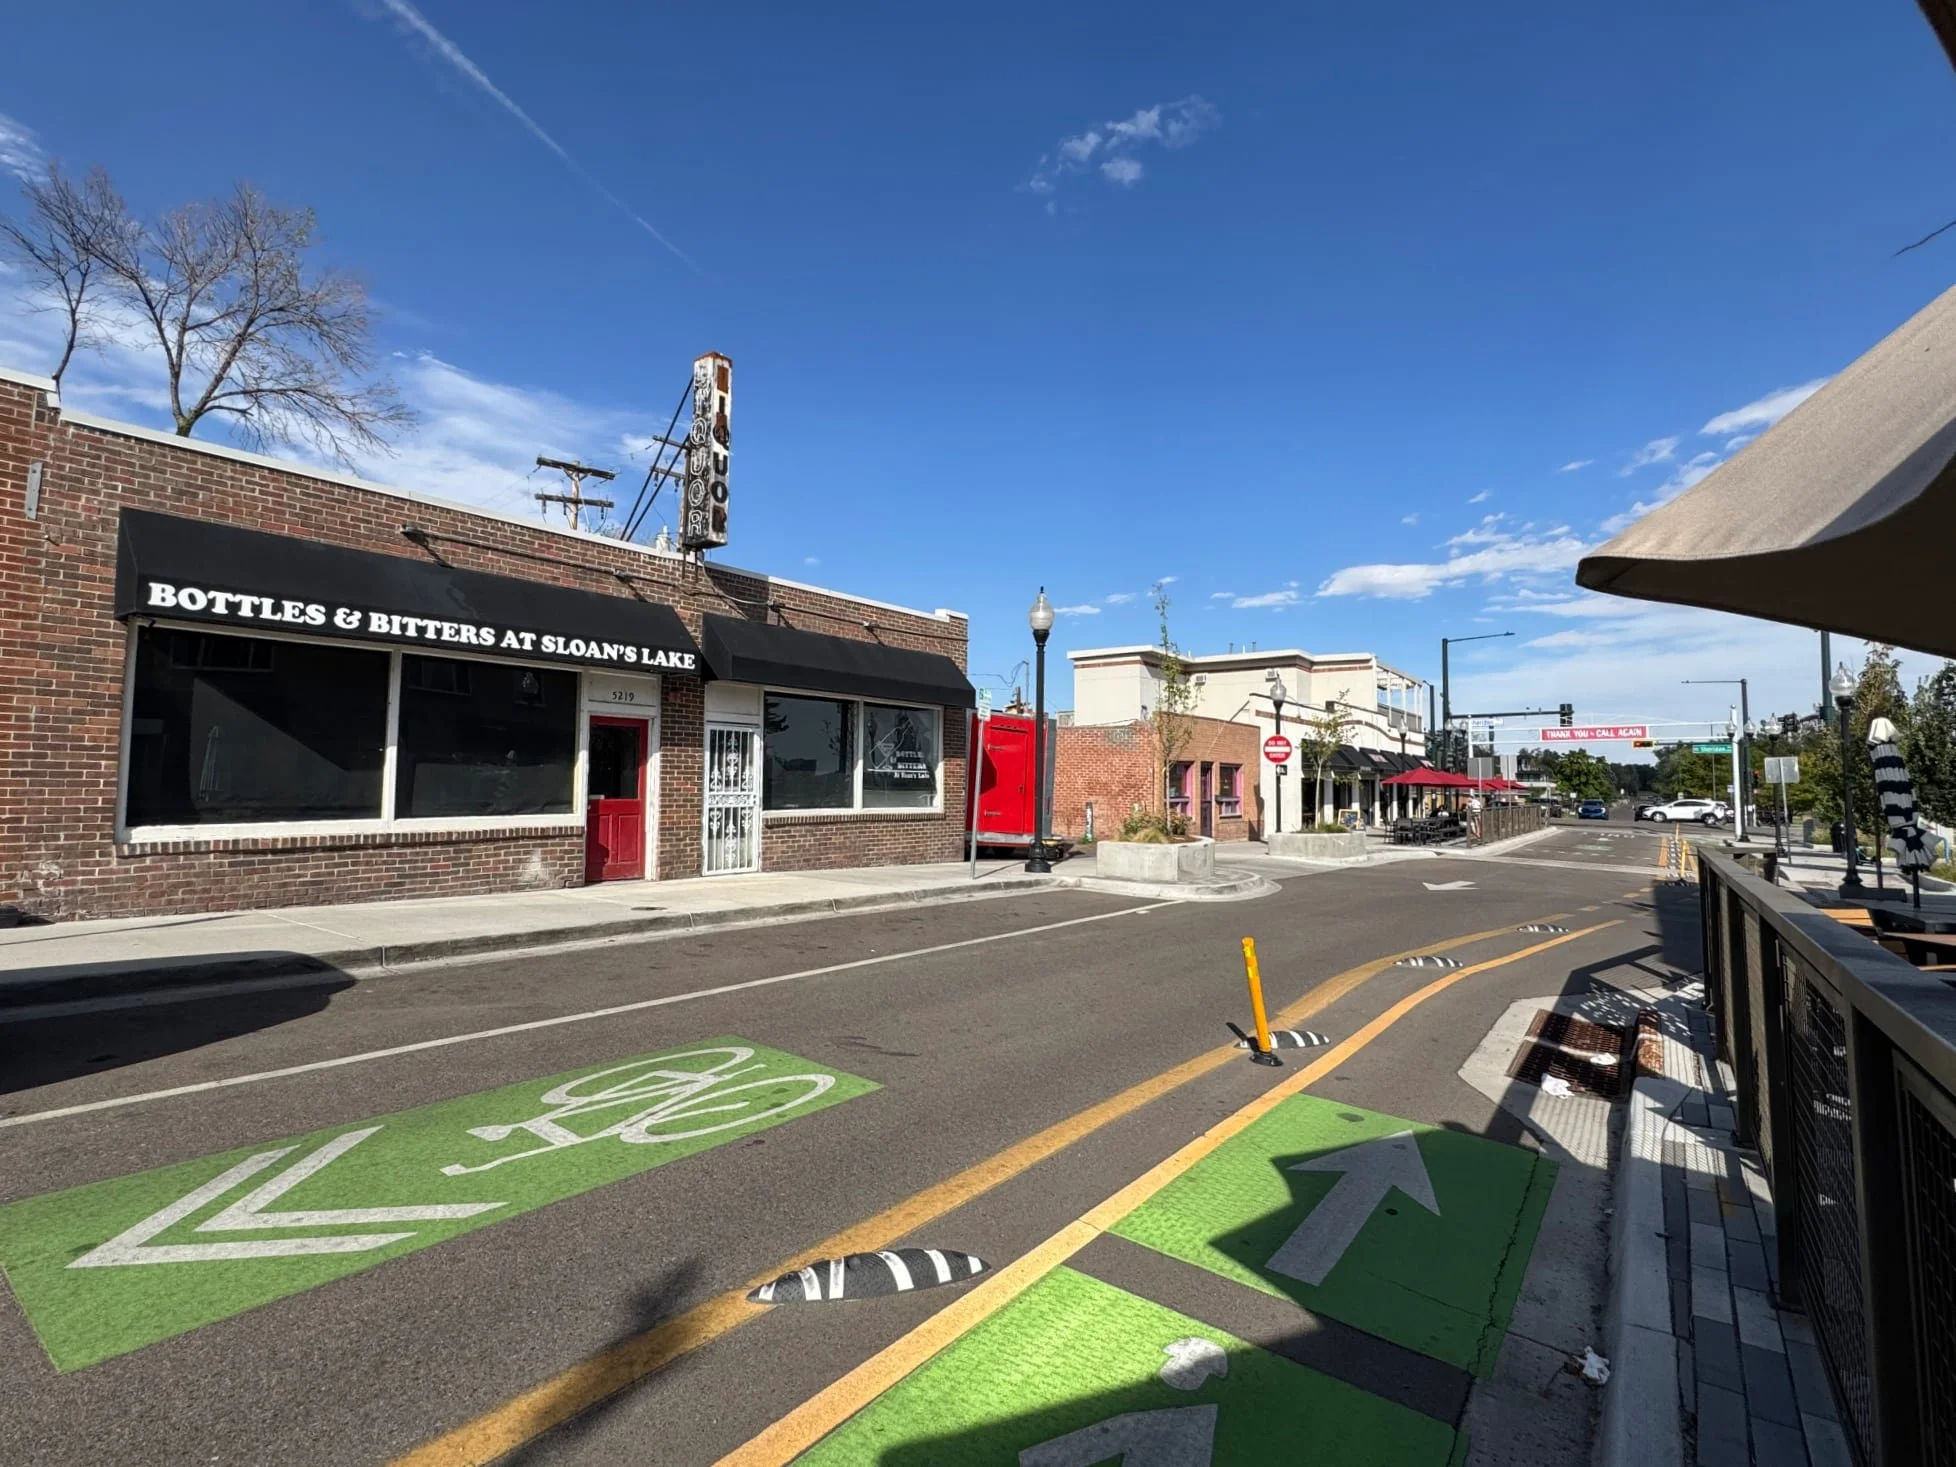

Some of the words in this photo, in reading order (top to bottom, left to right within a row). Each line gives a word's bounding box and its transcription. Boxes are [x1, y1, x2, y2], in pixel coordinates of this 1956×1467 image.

[147, 582, 326, 625] BOTTLES
[333, 607, 362, 629] &
[368, 612, 495, 645] BITTERS
[500, 630, 537, 650] AT
[541, 635, 637, 662] SLOAN'S
[641, 649, 696, 669] LAKE
[611, 690, 635, 701] 5219
[1574, 730, 1589, 738] YOU
[1596, 728, 1615, 737] CALL
[1618, 727, 1643, 736] AGAIN
